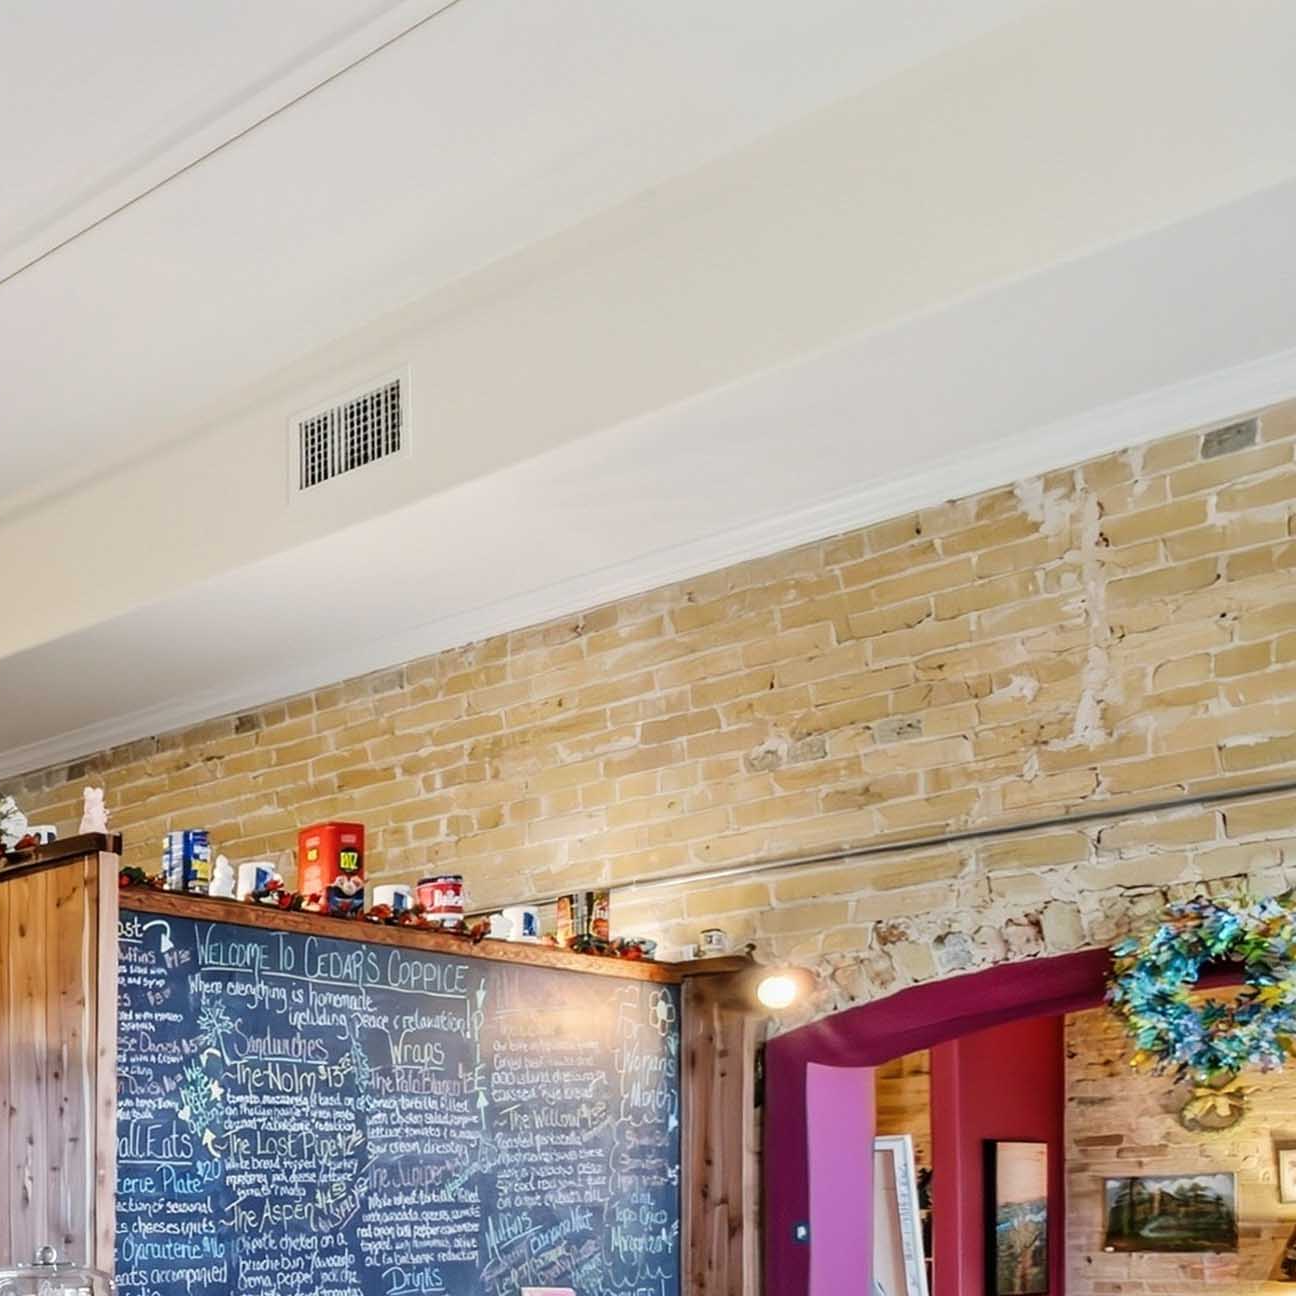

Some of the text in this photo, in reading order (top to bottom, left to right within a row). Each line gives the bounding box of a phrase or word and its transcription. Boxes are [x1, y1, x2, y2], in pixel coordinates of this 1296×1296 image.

[194, 923, 271, 971] WELCOME
[388, 950, 469, 993] COPPICE
[188, 972, 223, 998] Where
[227, 980, 287, 1014] everything
[292, 982, 304, 1003] is
[351, 1012, 389, 1037] peace
[389, 1029, 445, 1067] Wraps
[147, 1120, 193, 1159] Eats
[156, 1163, 204, 1193] Plate
[382, 1265, 443, 1296] Drinks
